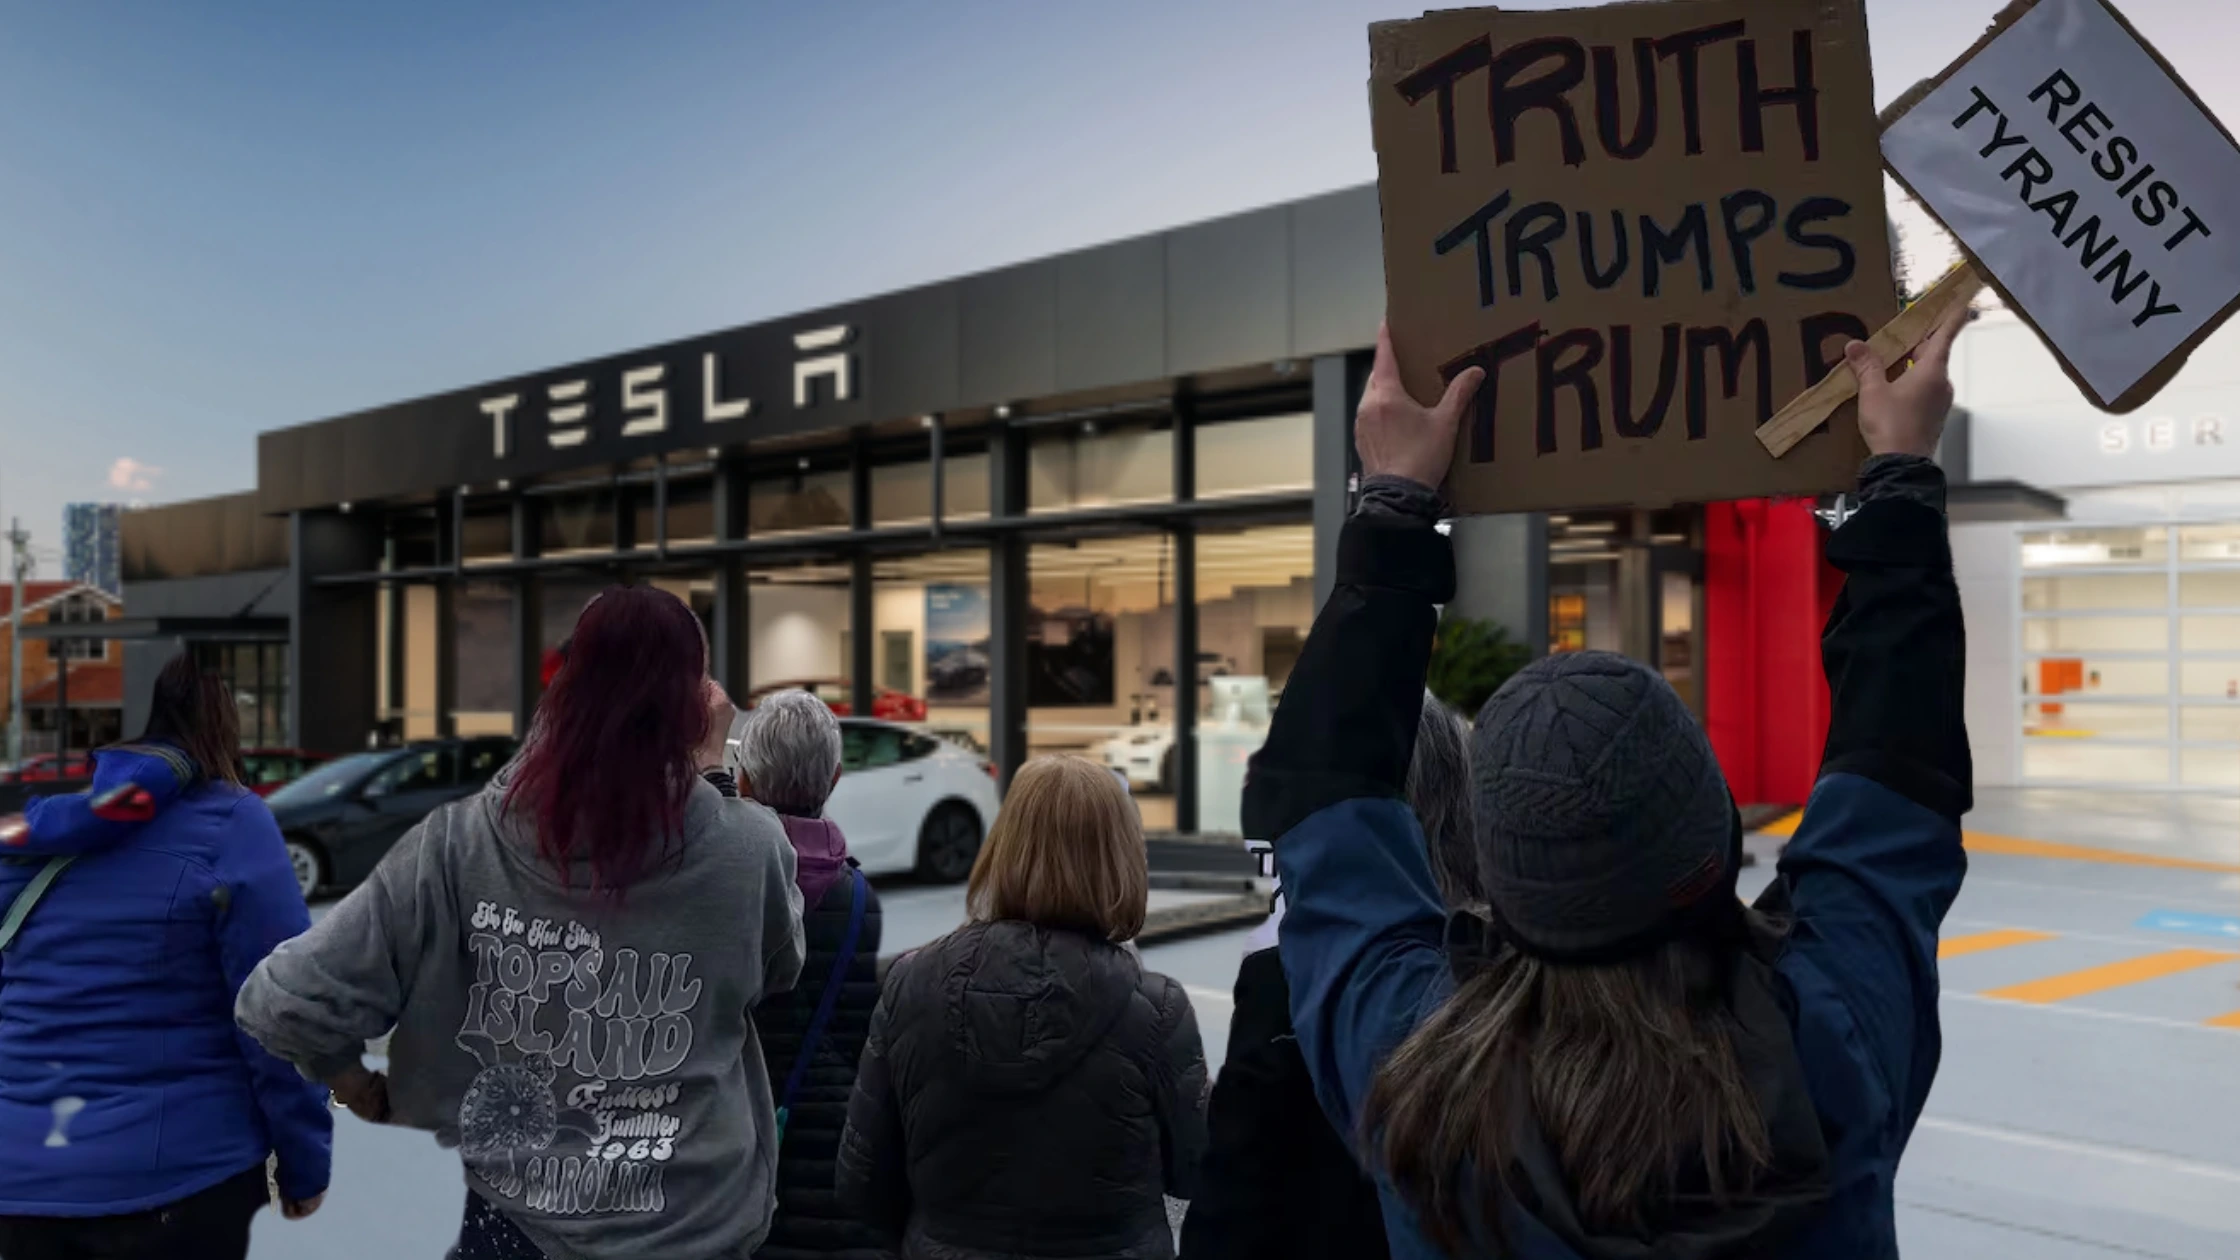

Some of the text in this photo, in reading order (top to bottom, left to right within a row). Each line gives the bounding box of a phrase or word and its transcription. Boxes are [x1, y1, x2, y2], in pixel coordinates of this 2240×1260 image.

[1395, 18, 1820, 174] TRUTH
[1951, 85, 2183, 329] TYRANNY
[2027, 68, 2212, 252] RESIST
[1434, 188, 1857, 308] TRUMPS
[479, 324, 851, 459] TESLA
[1437, 311, 1871, 464] TRUMP
[2102, 418, 2225, 450] SER
[468, 932, 702, 1018] TOPSAIL
[460, 983, 694, 1080] ISLAND
[566, 1080, 683, 1116] Endless
[591, 1110, 681, 1145] Summer
[525, 1156, 666, 1213] CAROLINA
